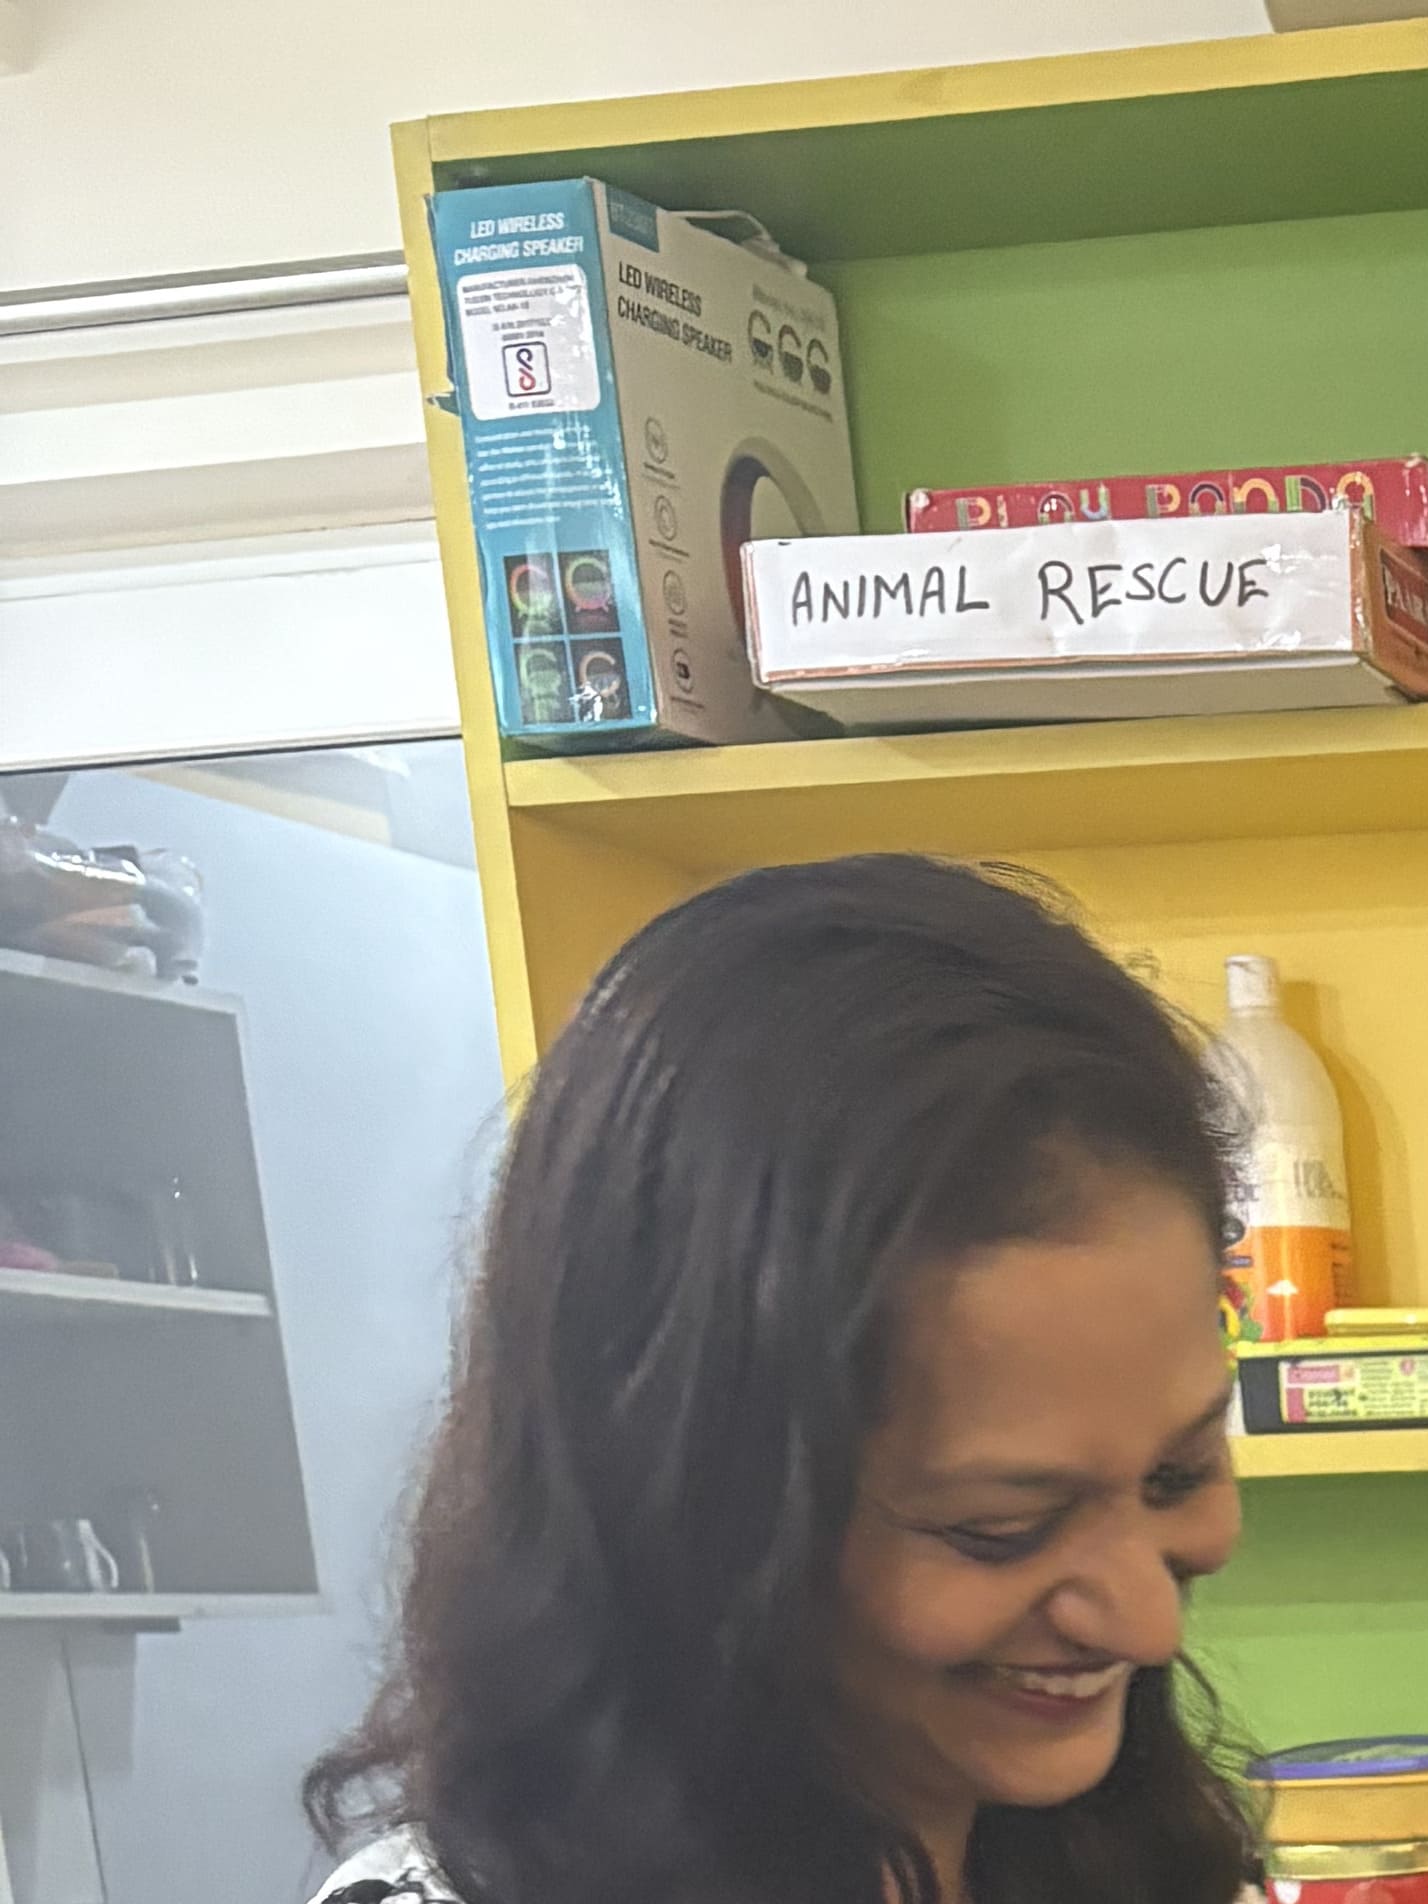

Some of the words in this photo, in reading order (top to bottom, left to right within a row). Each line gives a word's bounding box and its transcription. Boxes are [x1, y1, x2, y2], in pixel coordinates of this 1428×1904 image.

[454, 241, 520, 266] CHARGING
[523, 236, 584, 258] SPEAKER
[470, 219, 495, 239] LED
[499, 212, 565, 234] WIRELESS
[618, 260, 642, 290] LED
[644, 271, 703, 317] WIRELESS
[616, 295, 681, 341] CHARGING
[681, 322, 733, 364] SPEAKER
[791, 568, 990, 624] ANIMAL
[1037, 557, 1270, 625] RESCUE
